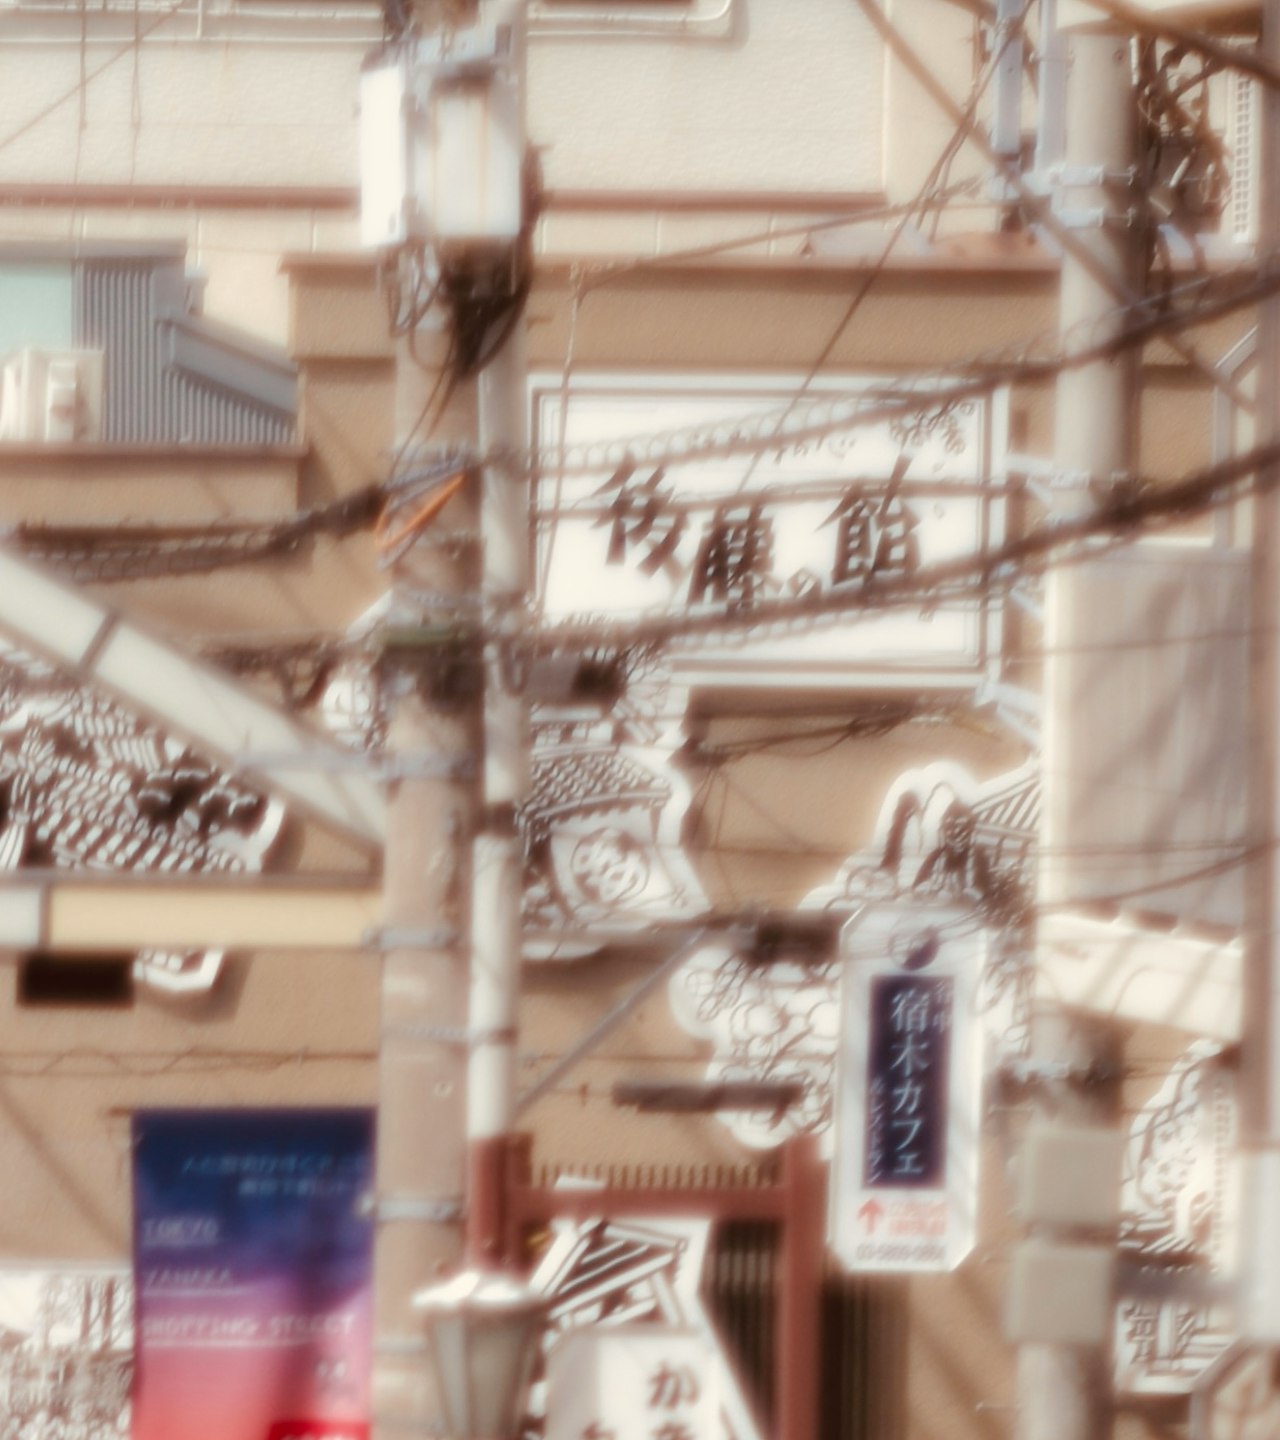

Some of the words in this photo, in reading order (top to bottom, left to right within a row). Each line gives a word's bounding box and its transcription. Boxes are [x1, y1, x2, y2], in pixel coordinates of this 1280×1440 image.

[891, 988, 930, 1175] 宿木カフェ
